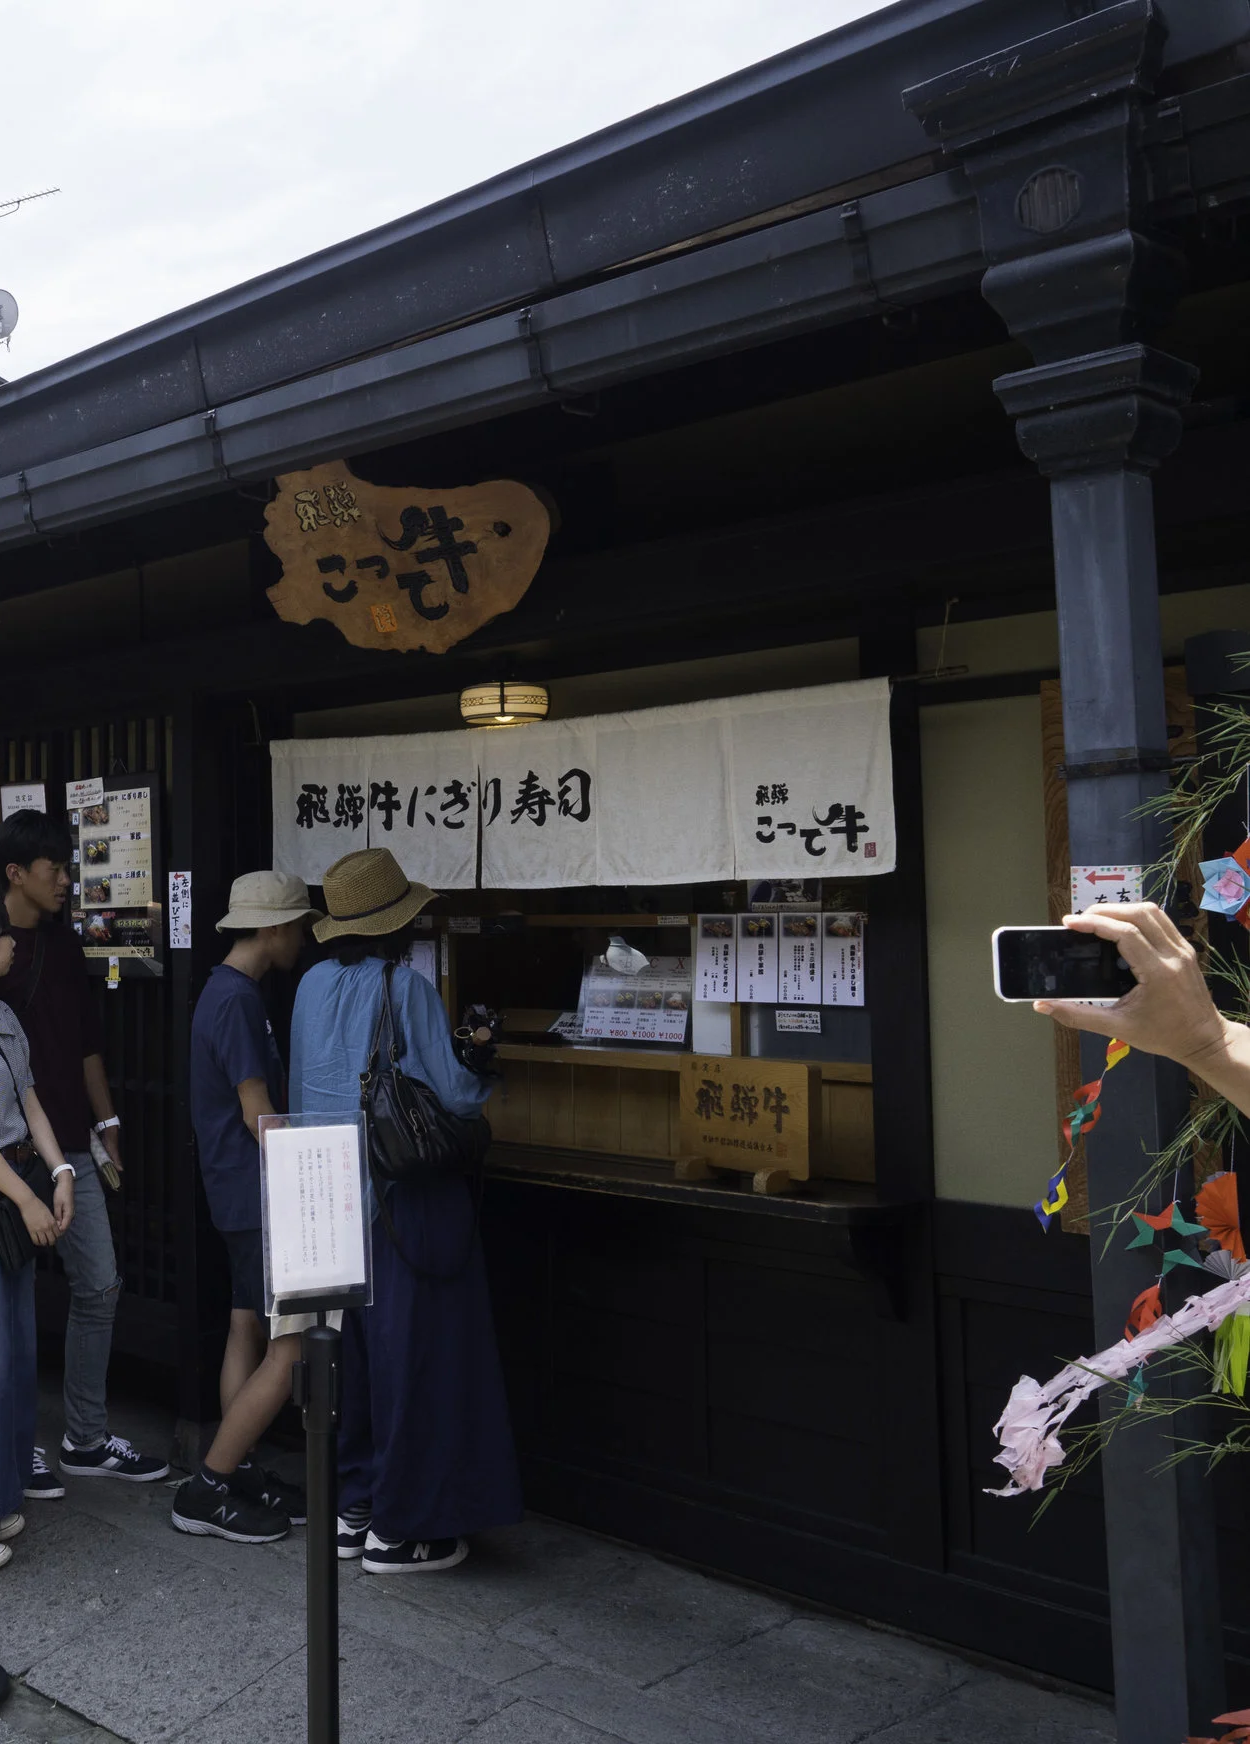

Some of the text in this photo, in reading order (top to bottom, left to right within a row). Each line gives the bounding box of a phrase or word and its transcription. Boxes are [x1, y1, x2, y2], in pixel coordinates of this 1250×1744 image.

[295, 768, 592, 832] 飛騨牛にぎり寿司
[755, 783, 789, 806] 飛騨
[171, 882, 181, 945] お並び下さい
[181, 878, 190, 909] 左側に
[584, 1028, 683, 1041] ¥700 ¥800 ¥1000 ¥1000
[695, 1079, 790, 1134] 飛騨牛
